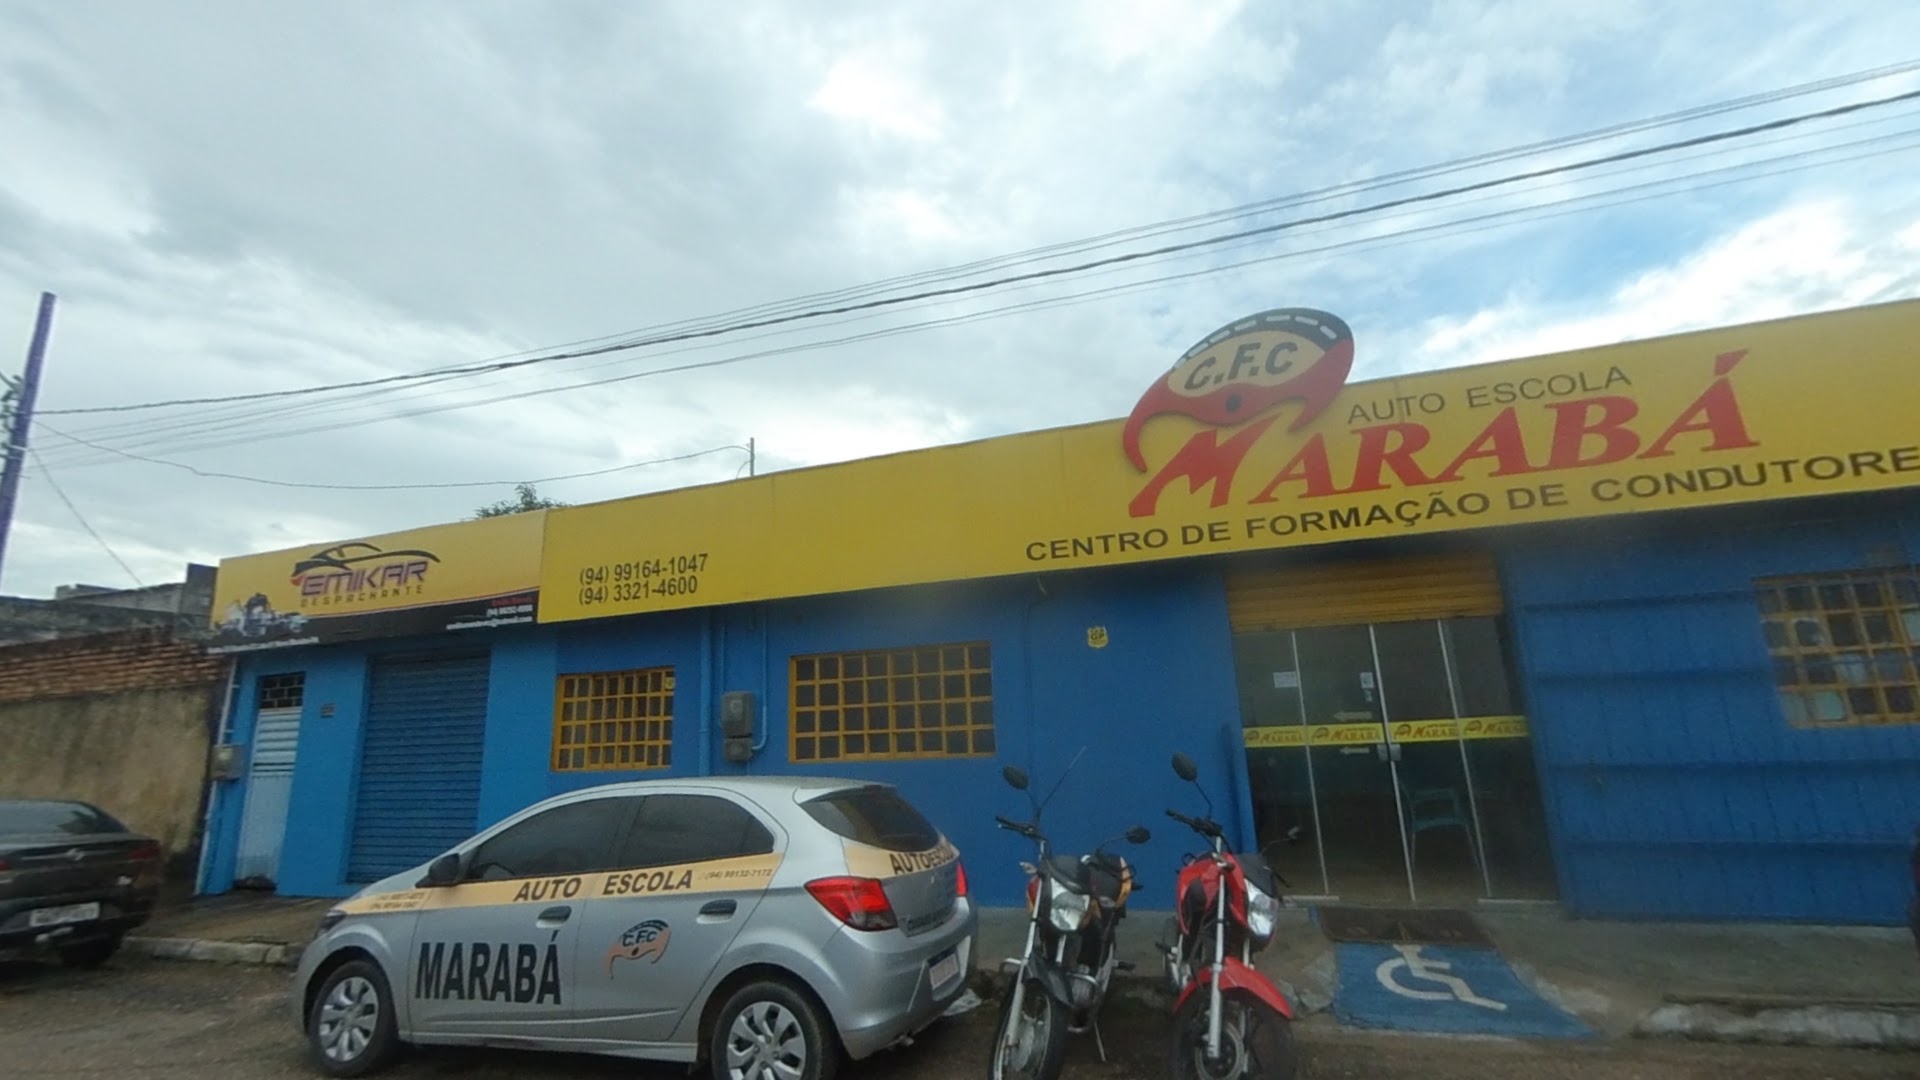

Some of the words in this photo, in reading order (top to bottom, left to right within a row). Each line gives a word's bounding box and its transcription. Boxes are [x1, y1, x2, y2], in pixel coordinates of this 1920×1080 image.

[1183, 341, 1299, 390] C.F.C
[1347, 392, 1446, 424] AUTO
[1466, 366, 1632, 409] ESCOLA
[1128, 348, 1761, 518] MARABÁ
[1025, 527, 1169, 561] CENTRO
[1181, 521, 1232, 546] DE
[1245, 491, 1490, 540] FORMAÇÃO
[1507, 483, 1566, 511] DE
[301, 561, 428, 596] EMIKAR
[579, 566, 609, 586] (94)
[614, 553, 708, 582] 99164-1047
[579, 585, 609, 605] (94)
[613, 575, 698, 602] 3321-4600
[299, 584, 424, 608] DESPACHANTE
[513, 877, 582, 902] AUTO
[602, 870, 693, 896] ESCOLA
[415, 929, 562, 1005] MARABÁ
